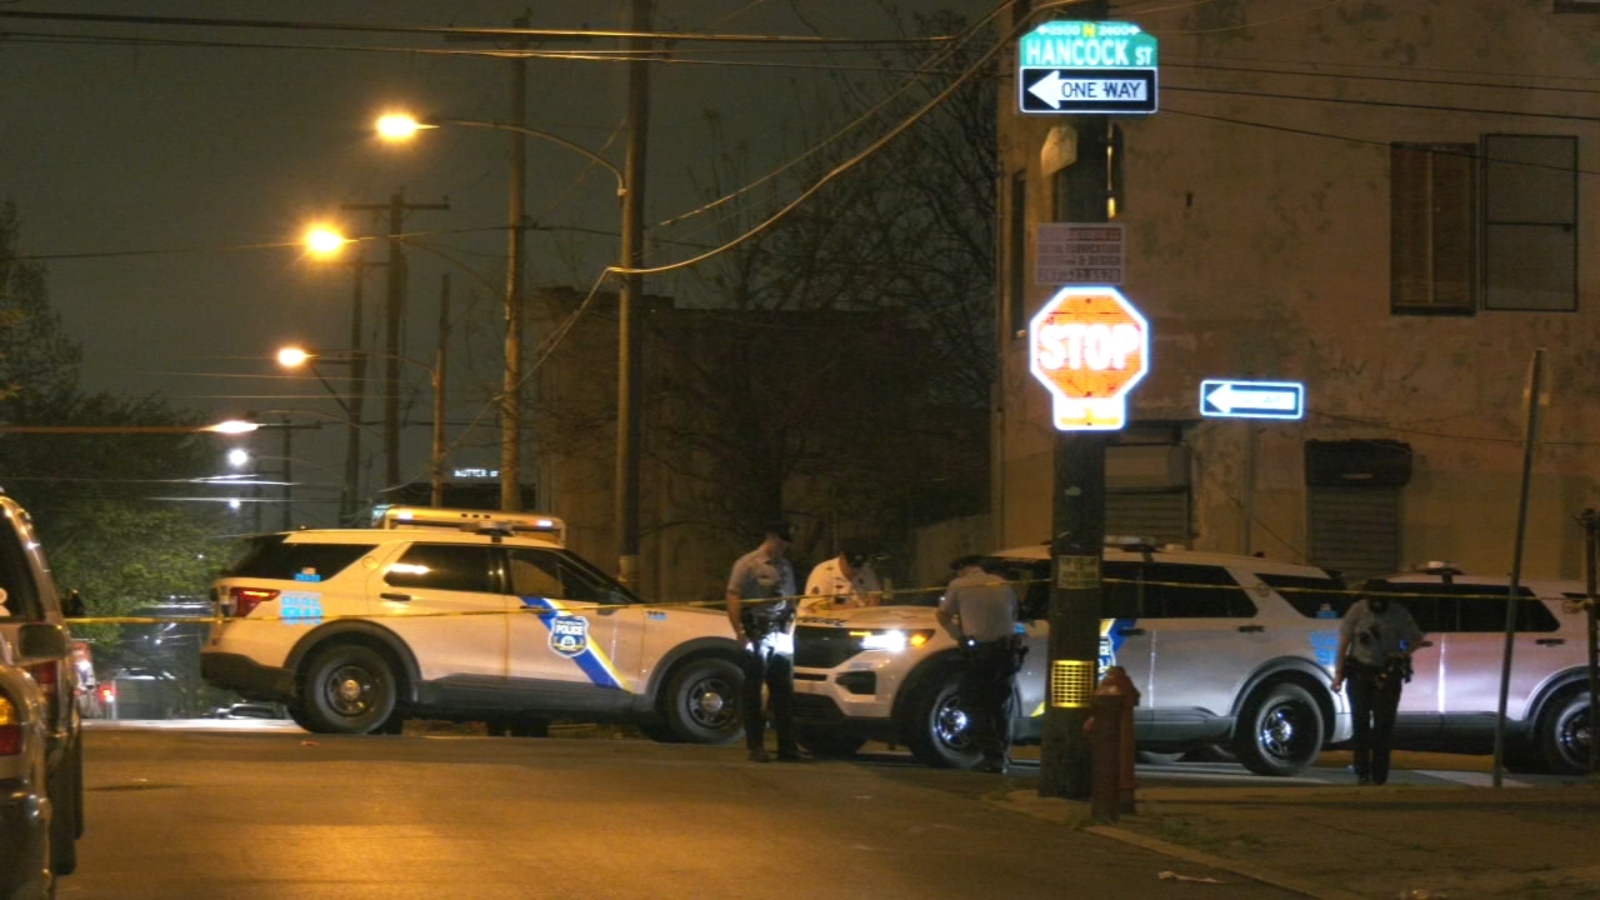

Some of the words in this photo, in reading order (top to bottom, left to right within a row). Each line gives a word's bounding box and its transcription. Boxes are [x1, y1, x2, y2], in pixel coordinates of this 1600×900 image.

[1026, 39, 1130, 66] HANCOCK
[1135, 46, 1153, 66] ST
[1061, 81, 1098, 98] ONE
[1102, 81, 1142, 98] WAY
[1039, 323, 1141, 371] STOP
[556, 624, 583, 636] POLICE
